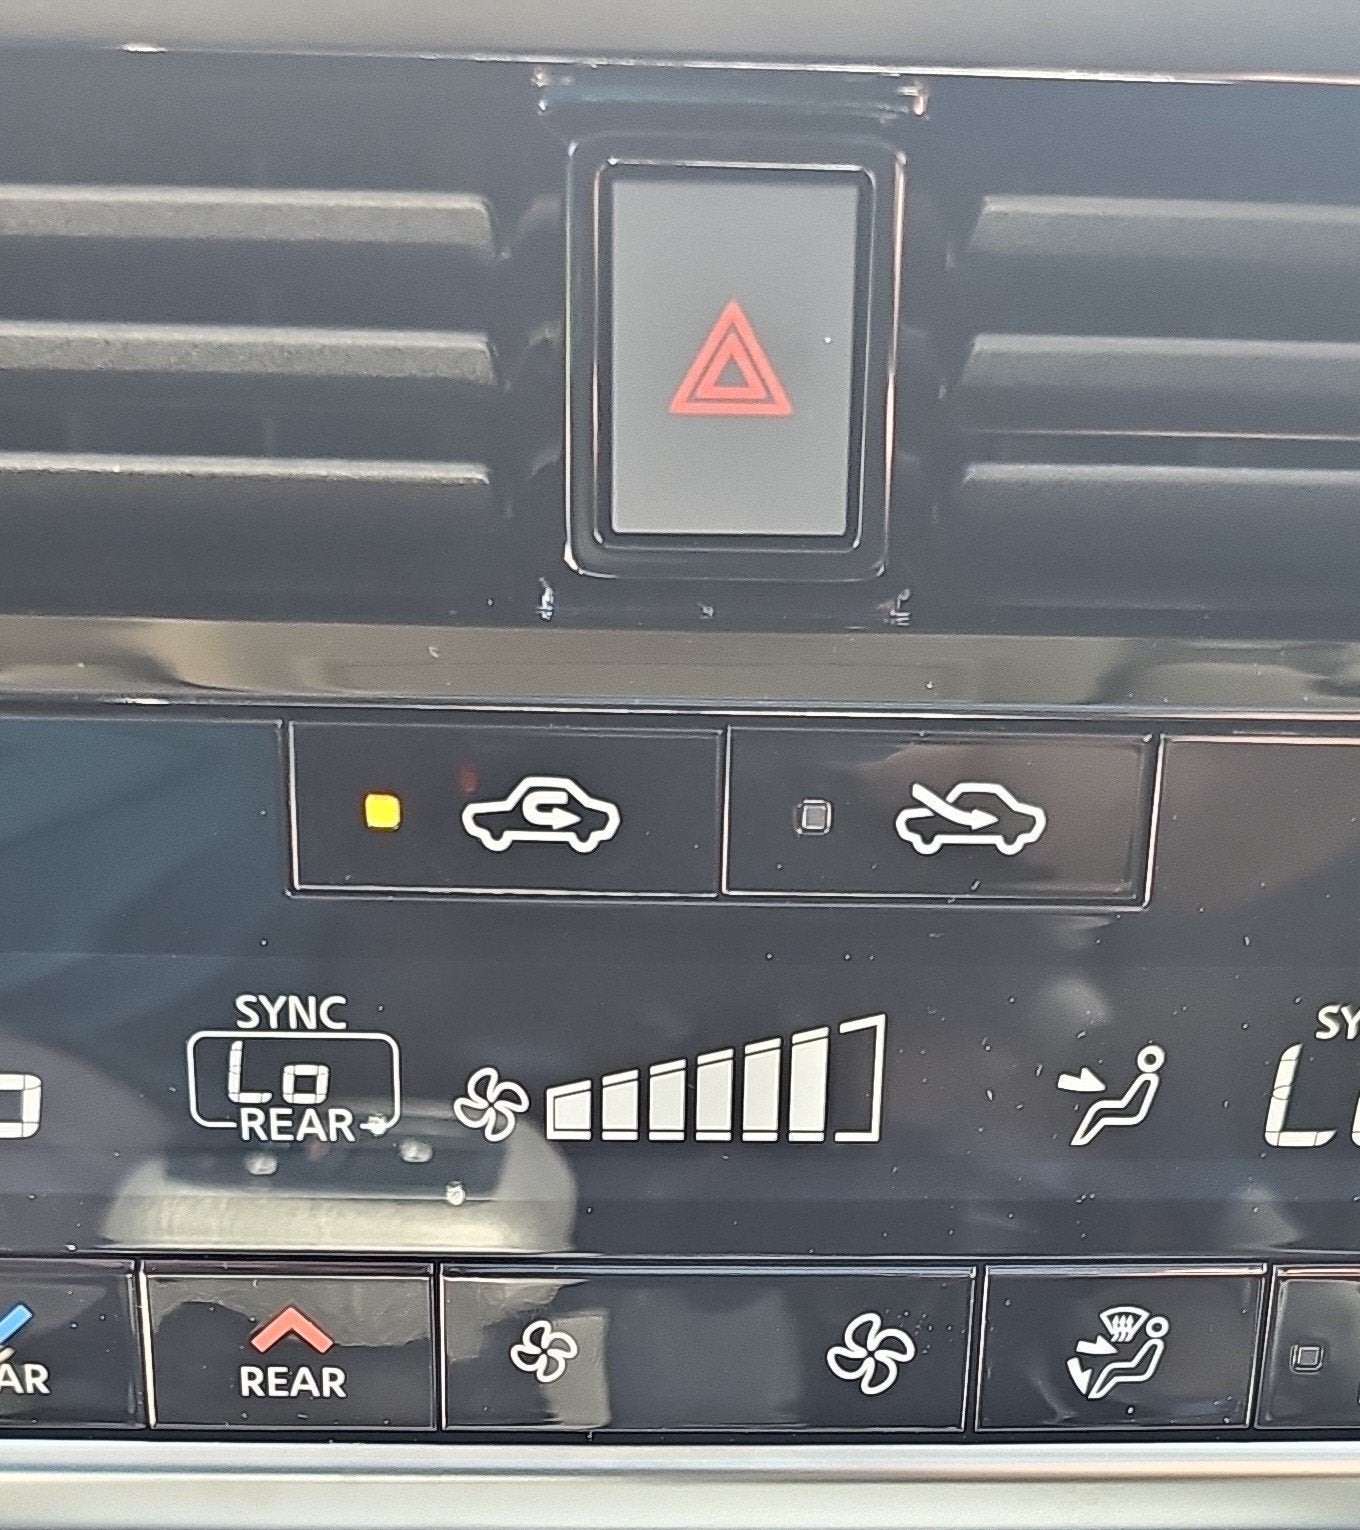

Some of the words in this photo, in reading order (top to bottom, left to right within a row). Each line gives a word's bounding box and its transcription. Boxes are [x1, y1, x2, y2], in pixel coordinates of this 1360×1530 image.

[234, 994, 348, 1031] SYNC
[240, 1106, 356, 1144] REAR
[240, 1366, 347, 1399] REAR
